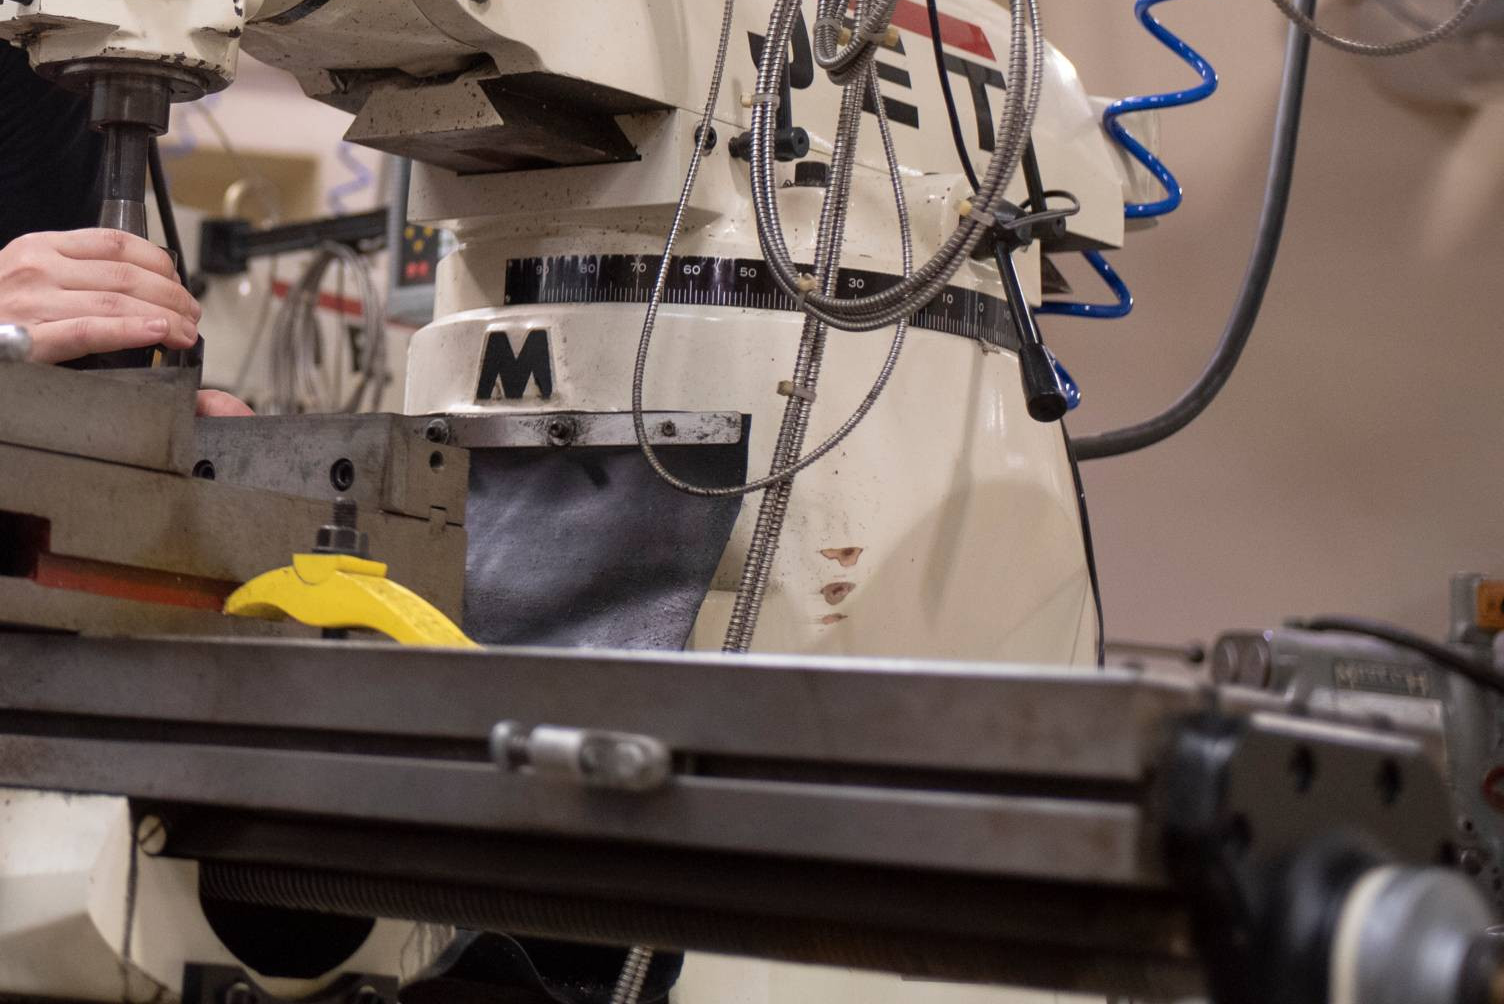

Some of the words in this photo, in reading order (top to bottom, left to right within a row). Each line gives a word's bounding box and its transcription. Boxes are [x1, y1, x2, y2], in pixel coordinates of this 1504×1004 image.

[536, 264, 549, 275] 90
[579, 263, 596, 274] 80
[630, 262, 647, 273] 70
[683, 264, 701, 276] 60
[739, 267, 757, 278] 50
[848, 277, 865, 289] 30
[942, 293, 954, 305] 10
[978, 302, 985, 313] 0
[476, 329, 553, 400] M
